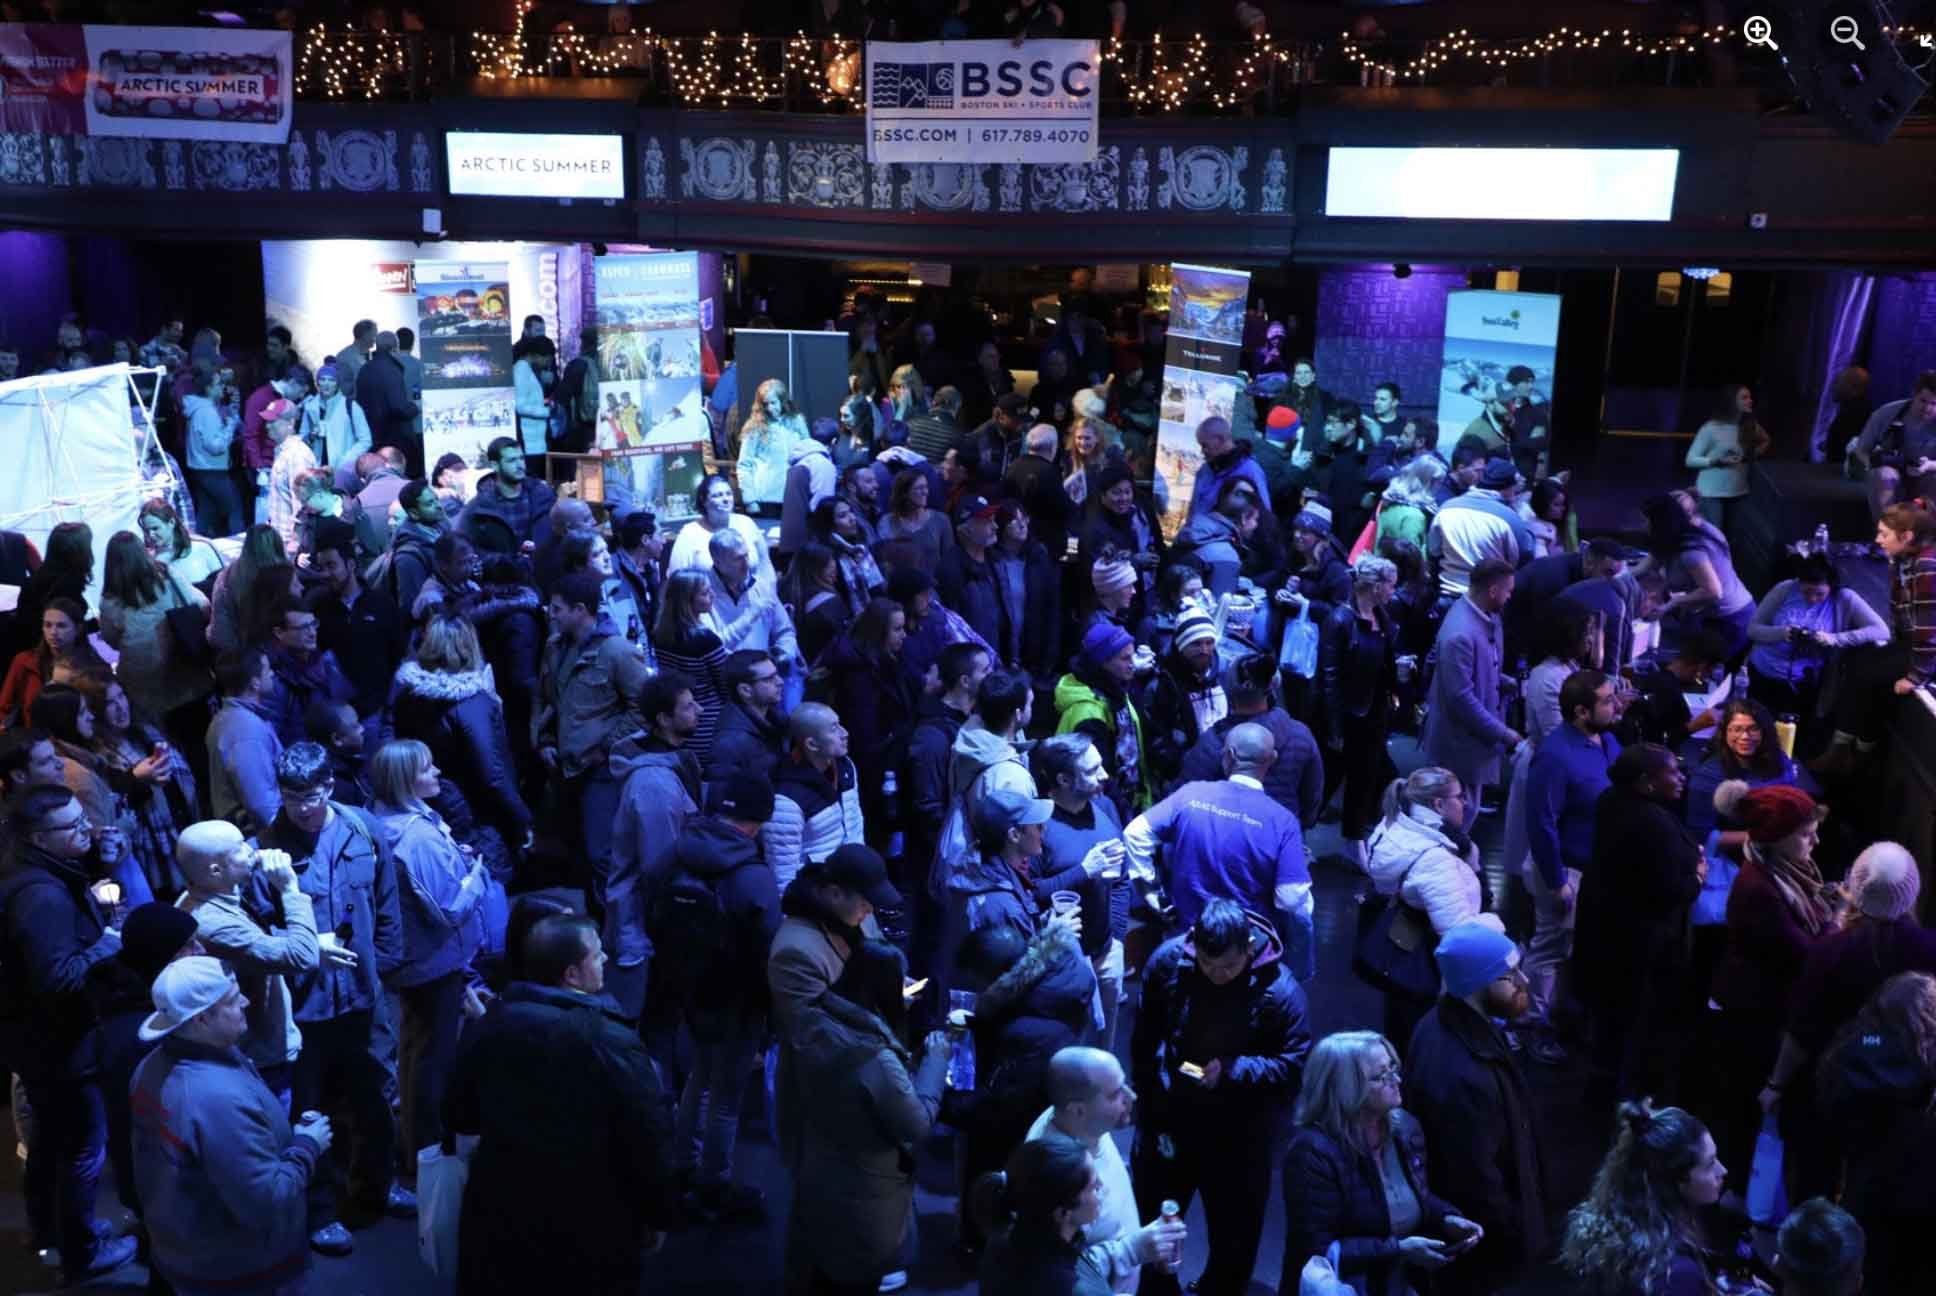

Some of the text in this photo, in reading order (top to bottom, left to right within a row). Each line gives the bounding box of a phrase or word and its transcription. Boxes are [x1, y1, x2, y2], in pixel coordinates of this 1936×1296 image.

[121, 77, 259, 95] ARCTIC SUMMER
[961, 60, 1092, 97] BSSC
[960, 101, 1092, 109] BOSTON SKI SPORTS CLUB
[873, 129, 1089, 143] BSSC.COM 617.789.4070
[461, 157, 612, 174] ARCTIC SUMMER
